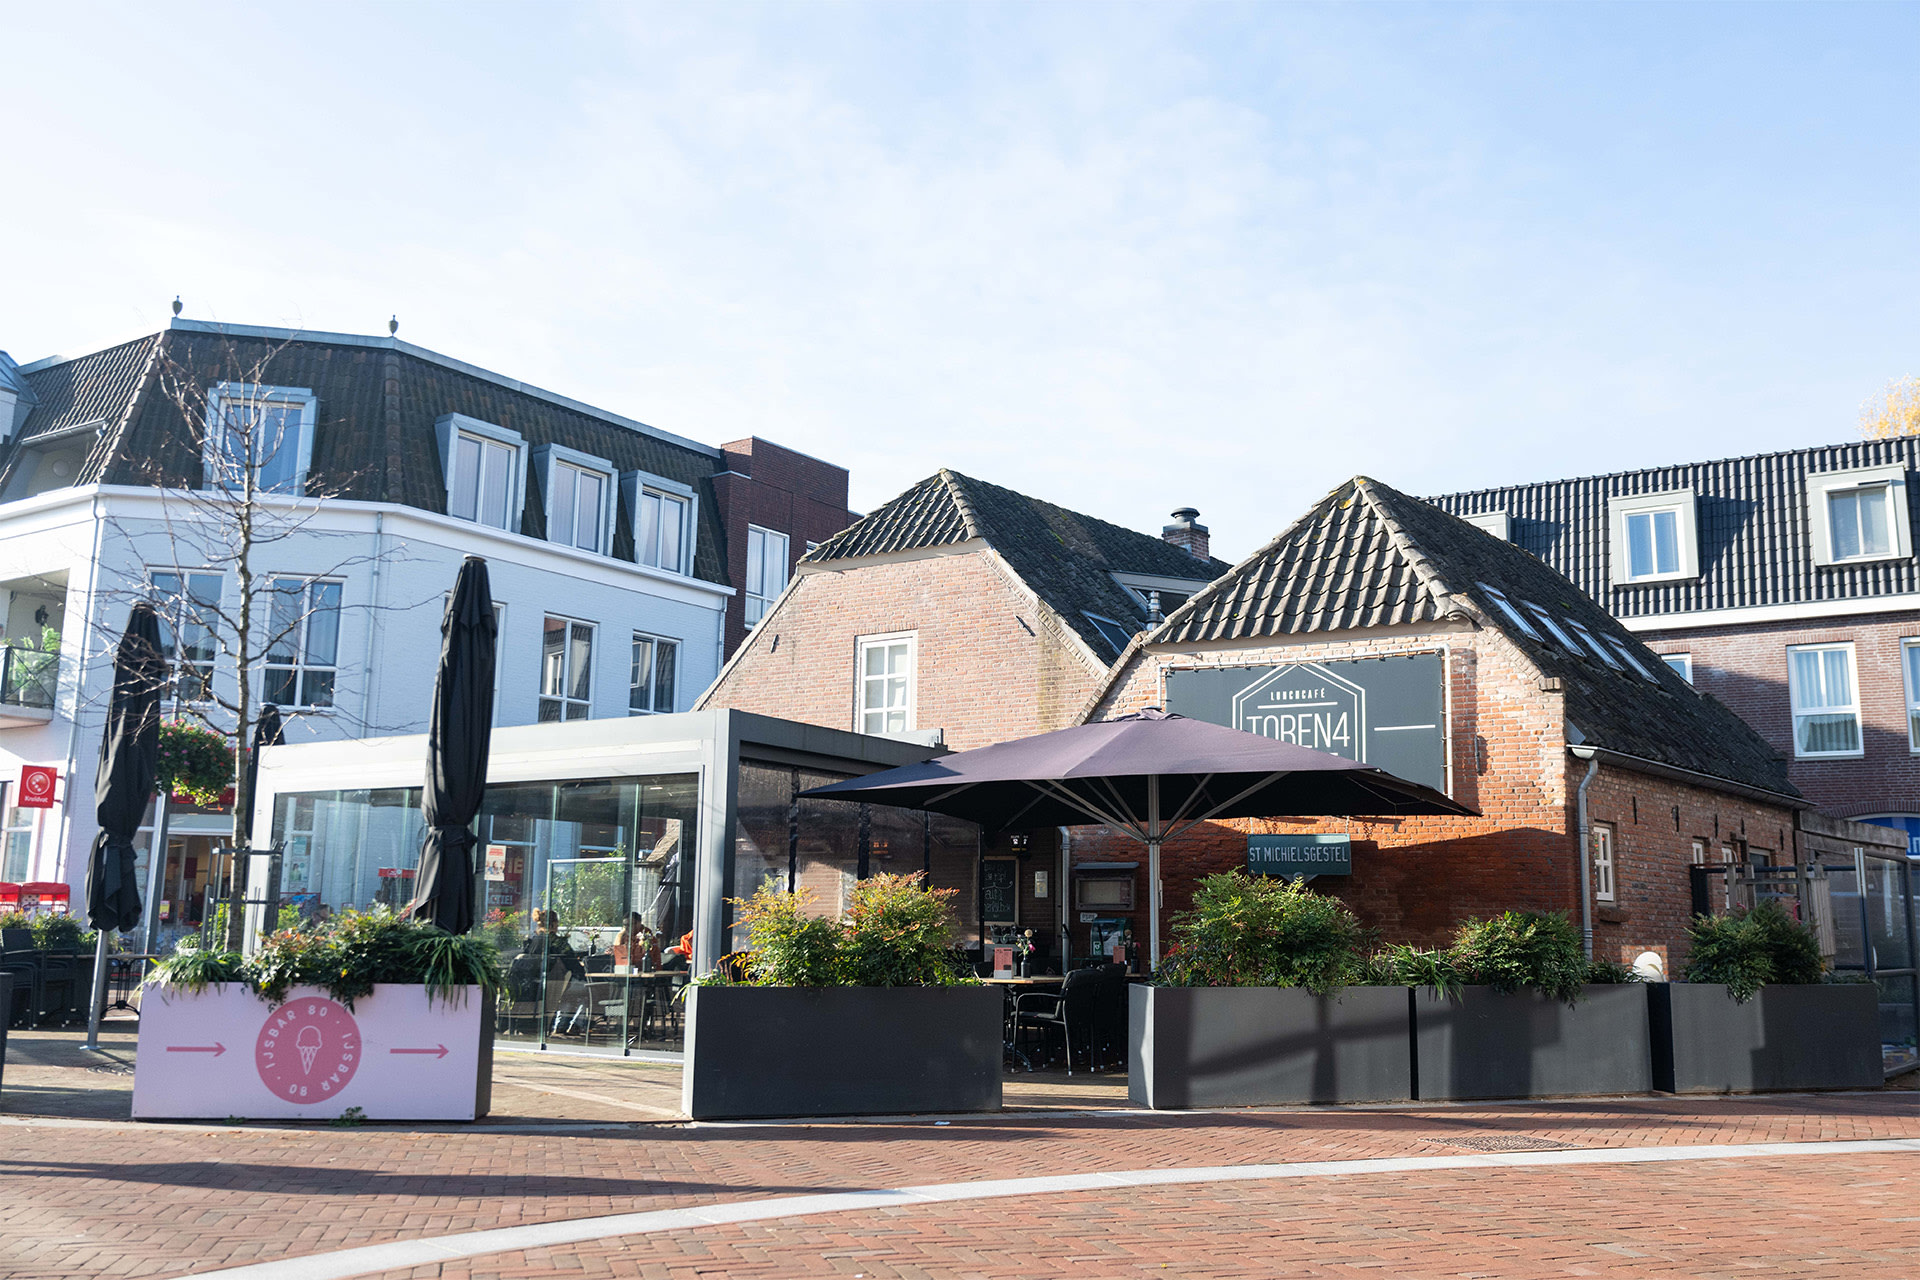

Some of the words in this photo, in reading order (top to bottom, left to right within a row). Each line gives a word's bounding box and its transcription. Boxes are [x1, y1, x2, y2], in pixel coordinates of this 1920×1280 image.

[1270, 687, 1326, 701] LUNCHCAFÉ
[1245, 711, 1351, 749] TOREN4
[1249, 847, 1261, 862] ST
[1264, 846, 1349, 862] MICHIELSGESTEL
[263, 1010, 297, 1069] IJSBAR
[320, 1032, 355, 1091] IJSBAR
